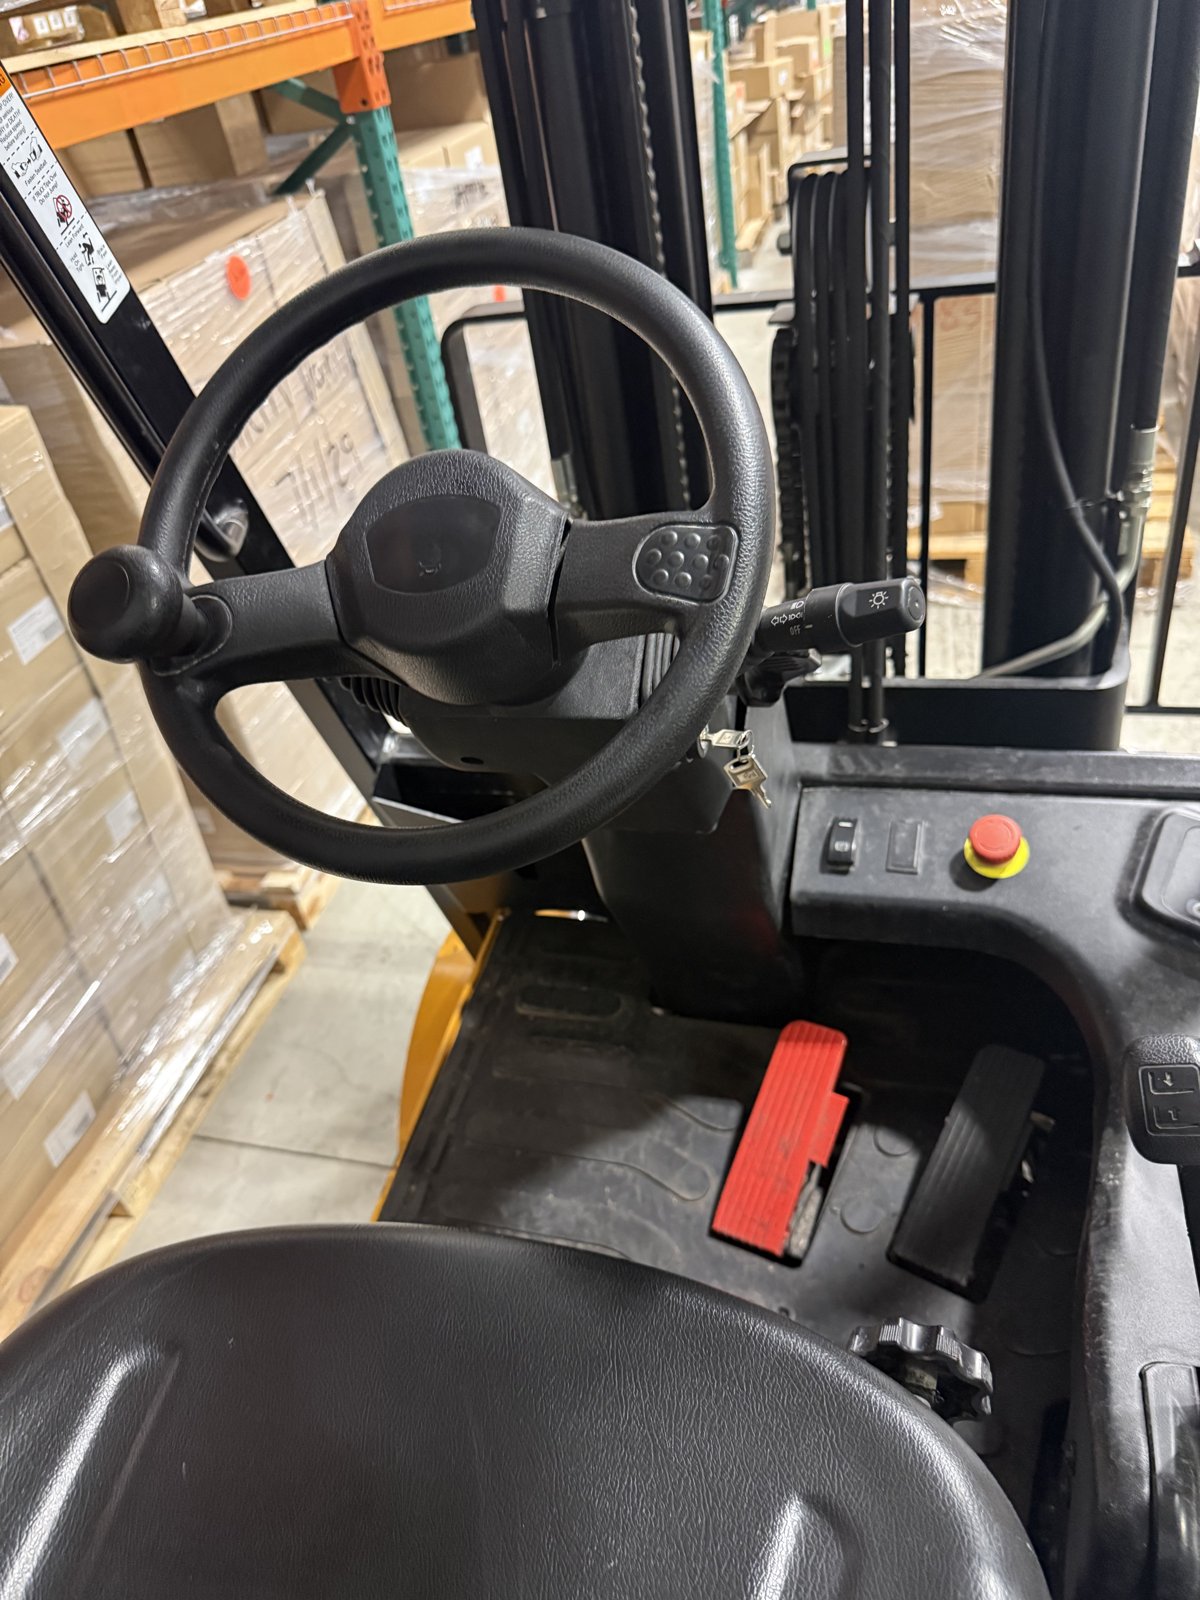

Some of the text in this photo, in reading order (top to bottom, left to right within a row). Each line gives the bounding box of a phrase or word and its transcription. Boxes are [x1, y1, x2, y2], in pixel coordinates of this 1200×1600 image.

[24, 159, 47, 186] Fasten Seatbelt
[34, 185, 44, 198] TRUCK
[43, 179, 51, 189] Tips
[49, 170, 57, 181] Over
[38, 196, 45, 205] Do
[48, 180, 58, 194] Jump!
[65, 223, 83, 248] Lean Forward
[790, 624, 800, 635] OFF
